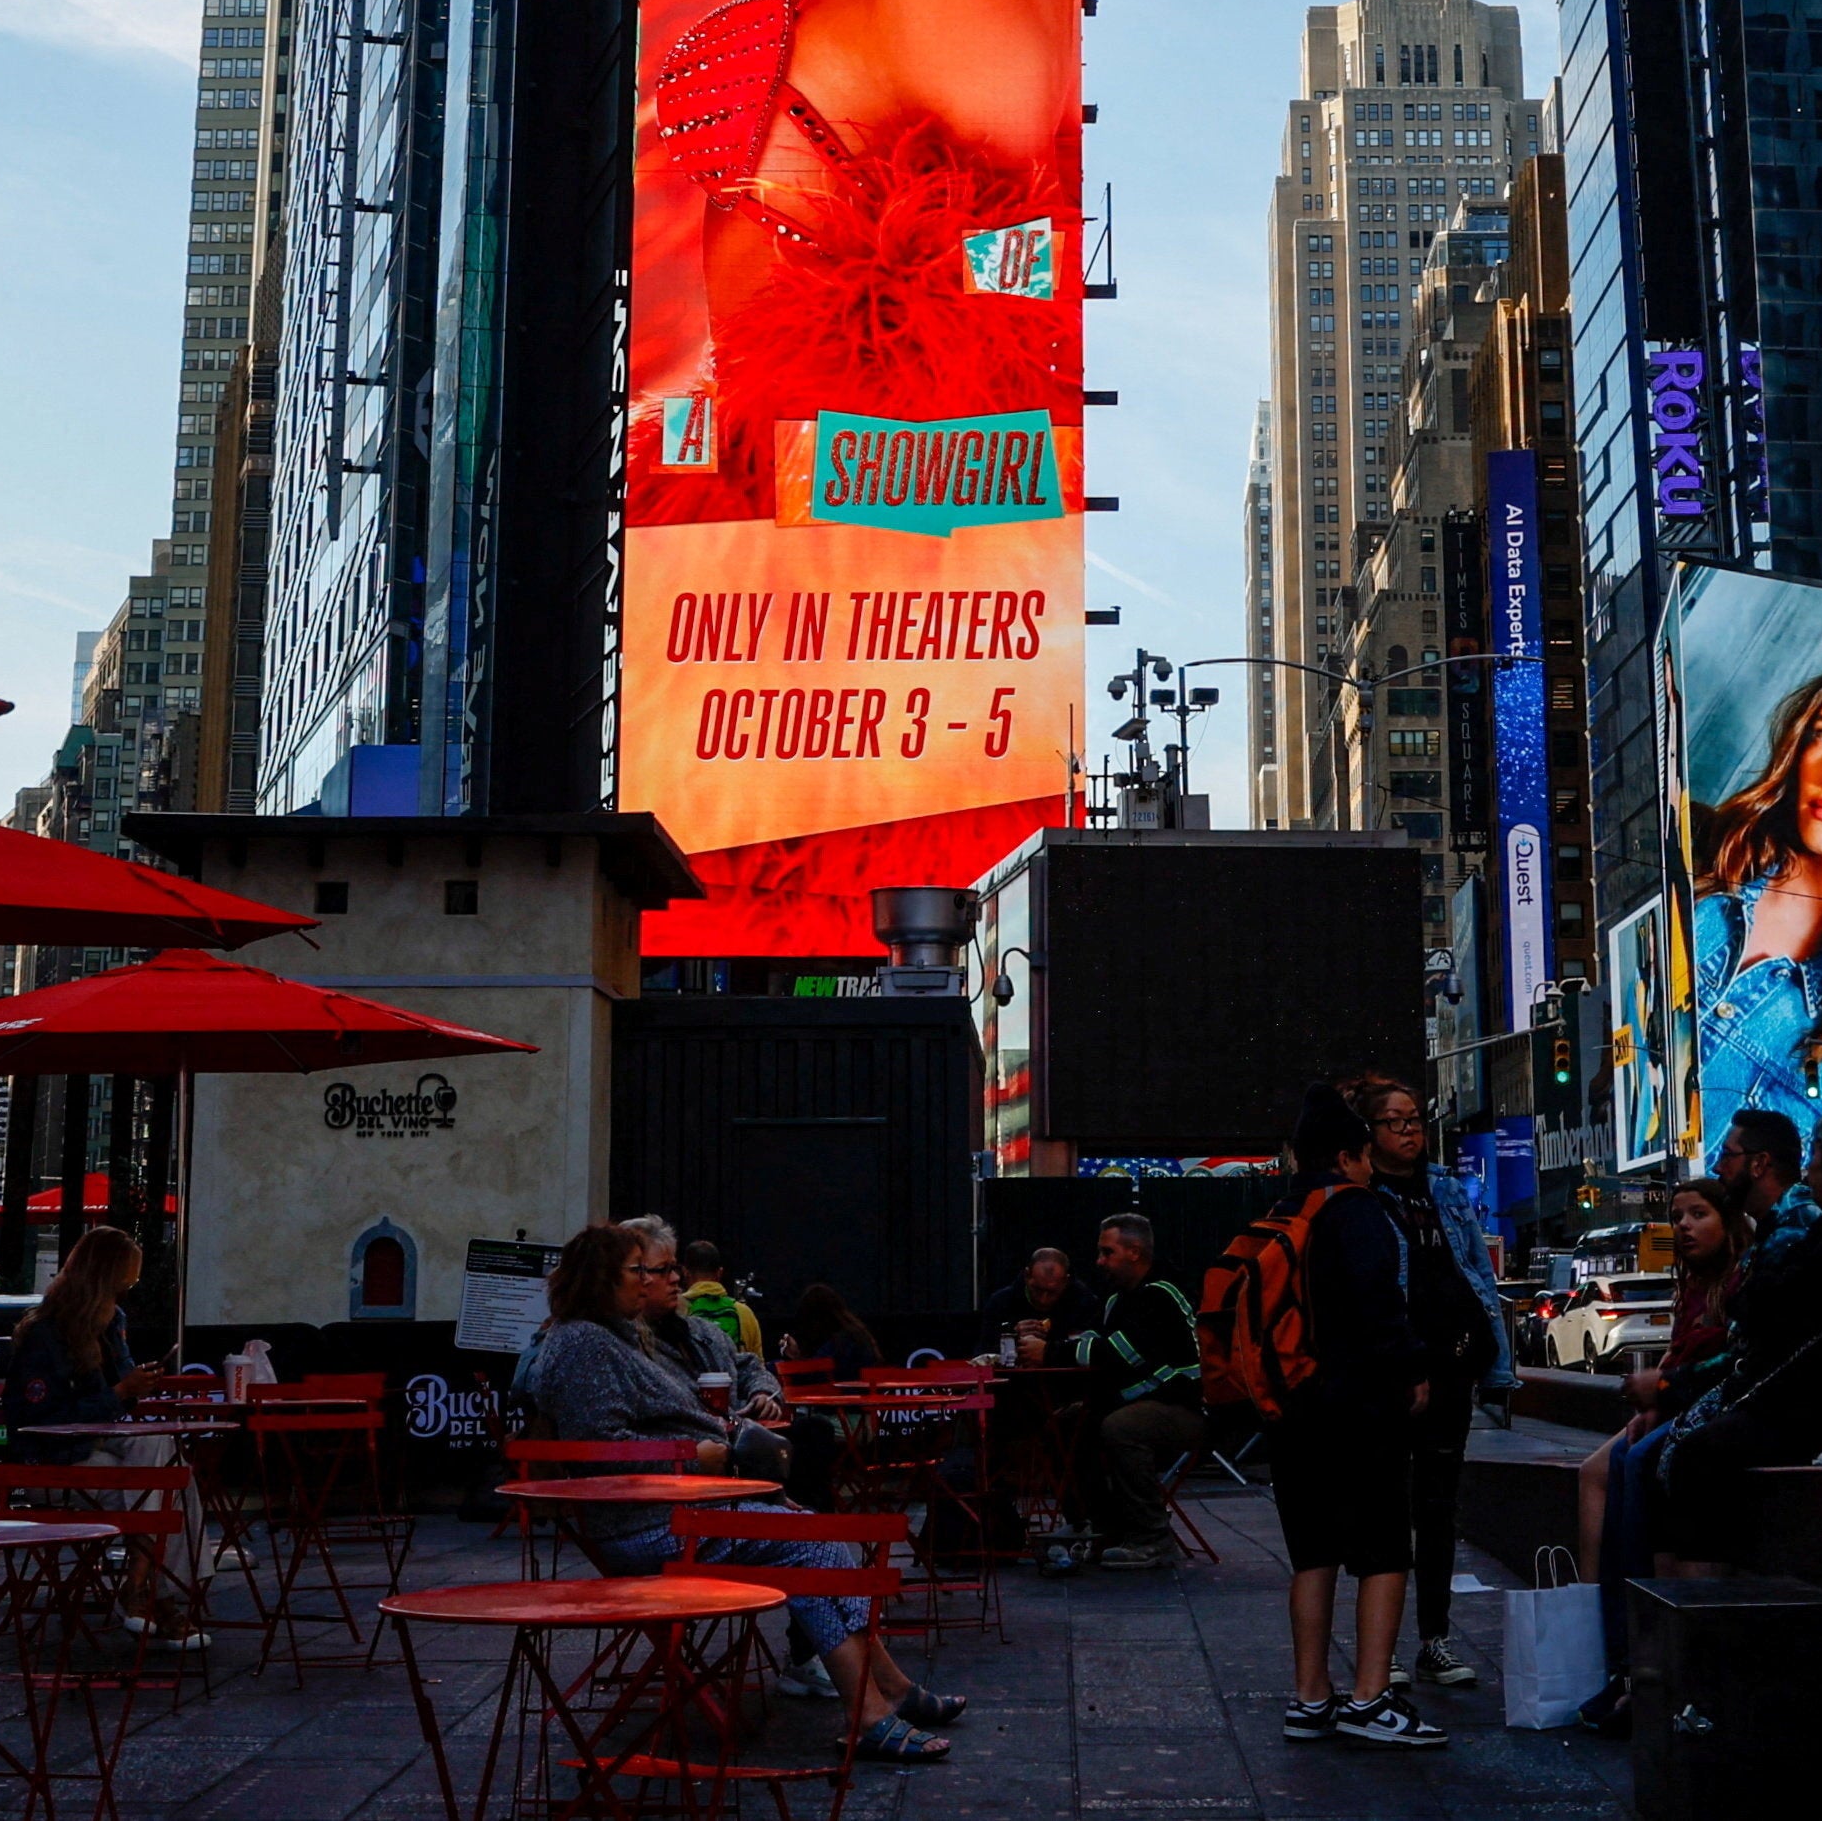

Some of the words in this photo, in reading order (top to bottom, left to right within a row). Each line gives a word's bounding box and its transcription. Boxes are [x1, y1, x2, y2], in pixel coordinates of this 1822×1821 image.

[1000, 229, 1045, 288] OF
[679, 391, 711, 463] A
[825, 430, 1048, 506] SHOWGIRL
[1505, 502, 1523, 527] AI
[1456, 533, 1468, 629] TIMES
[1506, 530, 1524, 577] Data
[666, 592, 771, 662] ONLY
[783, 592, 830, 661] IN
[847, 590, 1046, 660] THEATERS
[1506, 581, 1525, 658] Experts
[695, 688, 889, 760] OCTOBER
[901, 687, 931, 757] 3
[984, 687, 1015, 759] 5
[1460, 702, 1473, 823] SQUARE
[1513, 841, 1534, 907] Quest
[1524, 940, 1534, 995] quest.com
[324, 1083, 435, 1129] Buchette
[357, 1117, 384, 1128] DEL
[391, 1117, 429, 1128] VINO
[1536, 1103, 1614, 1171] Timberland
[449, 1441, 471, 1449] NEW
[450, 1421, 486, 1435] DEL
